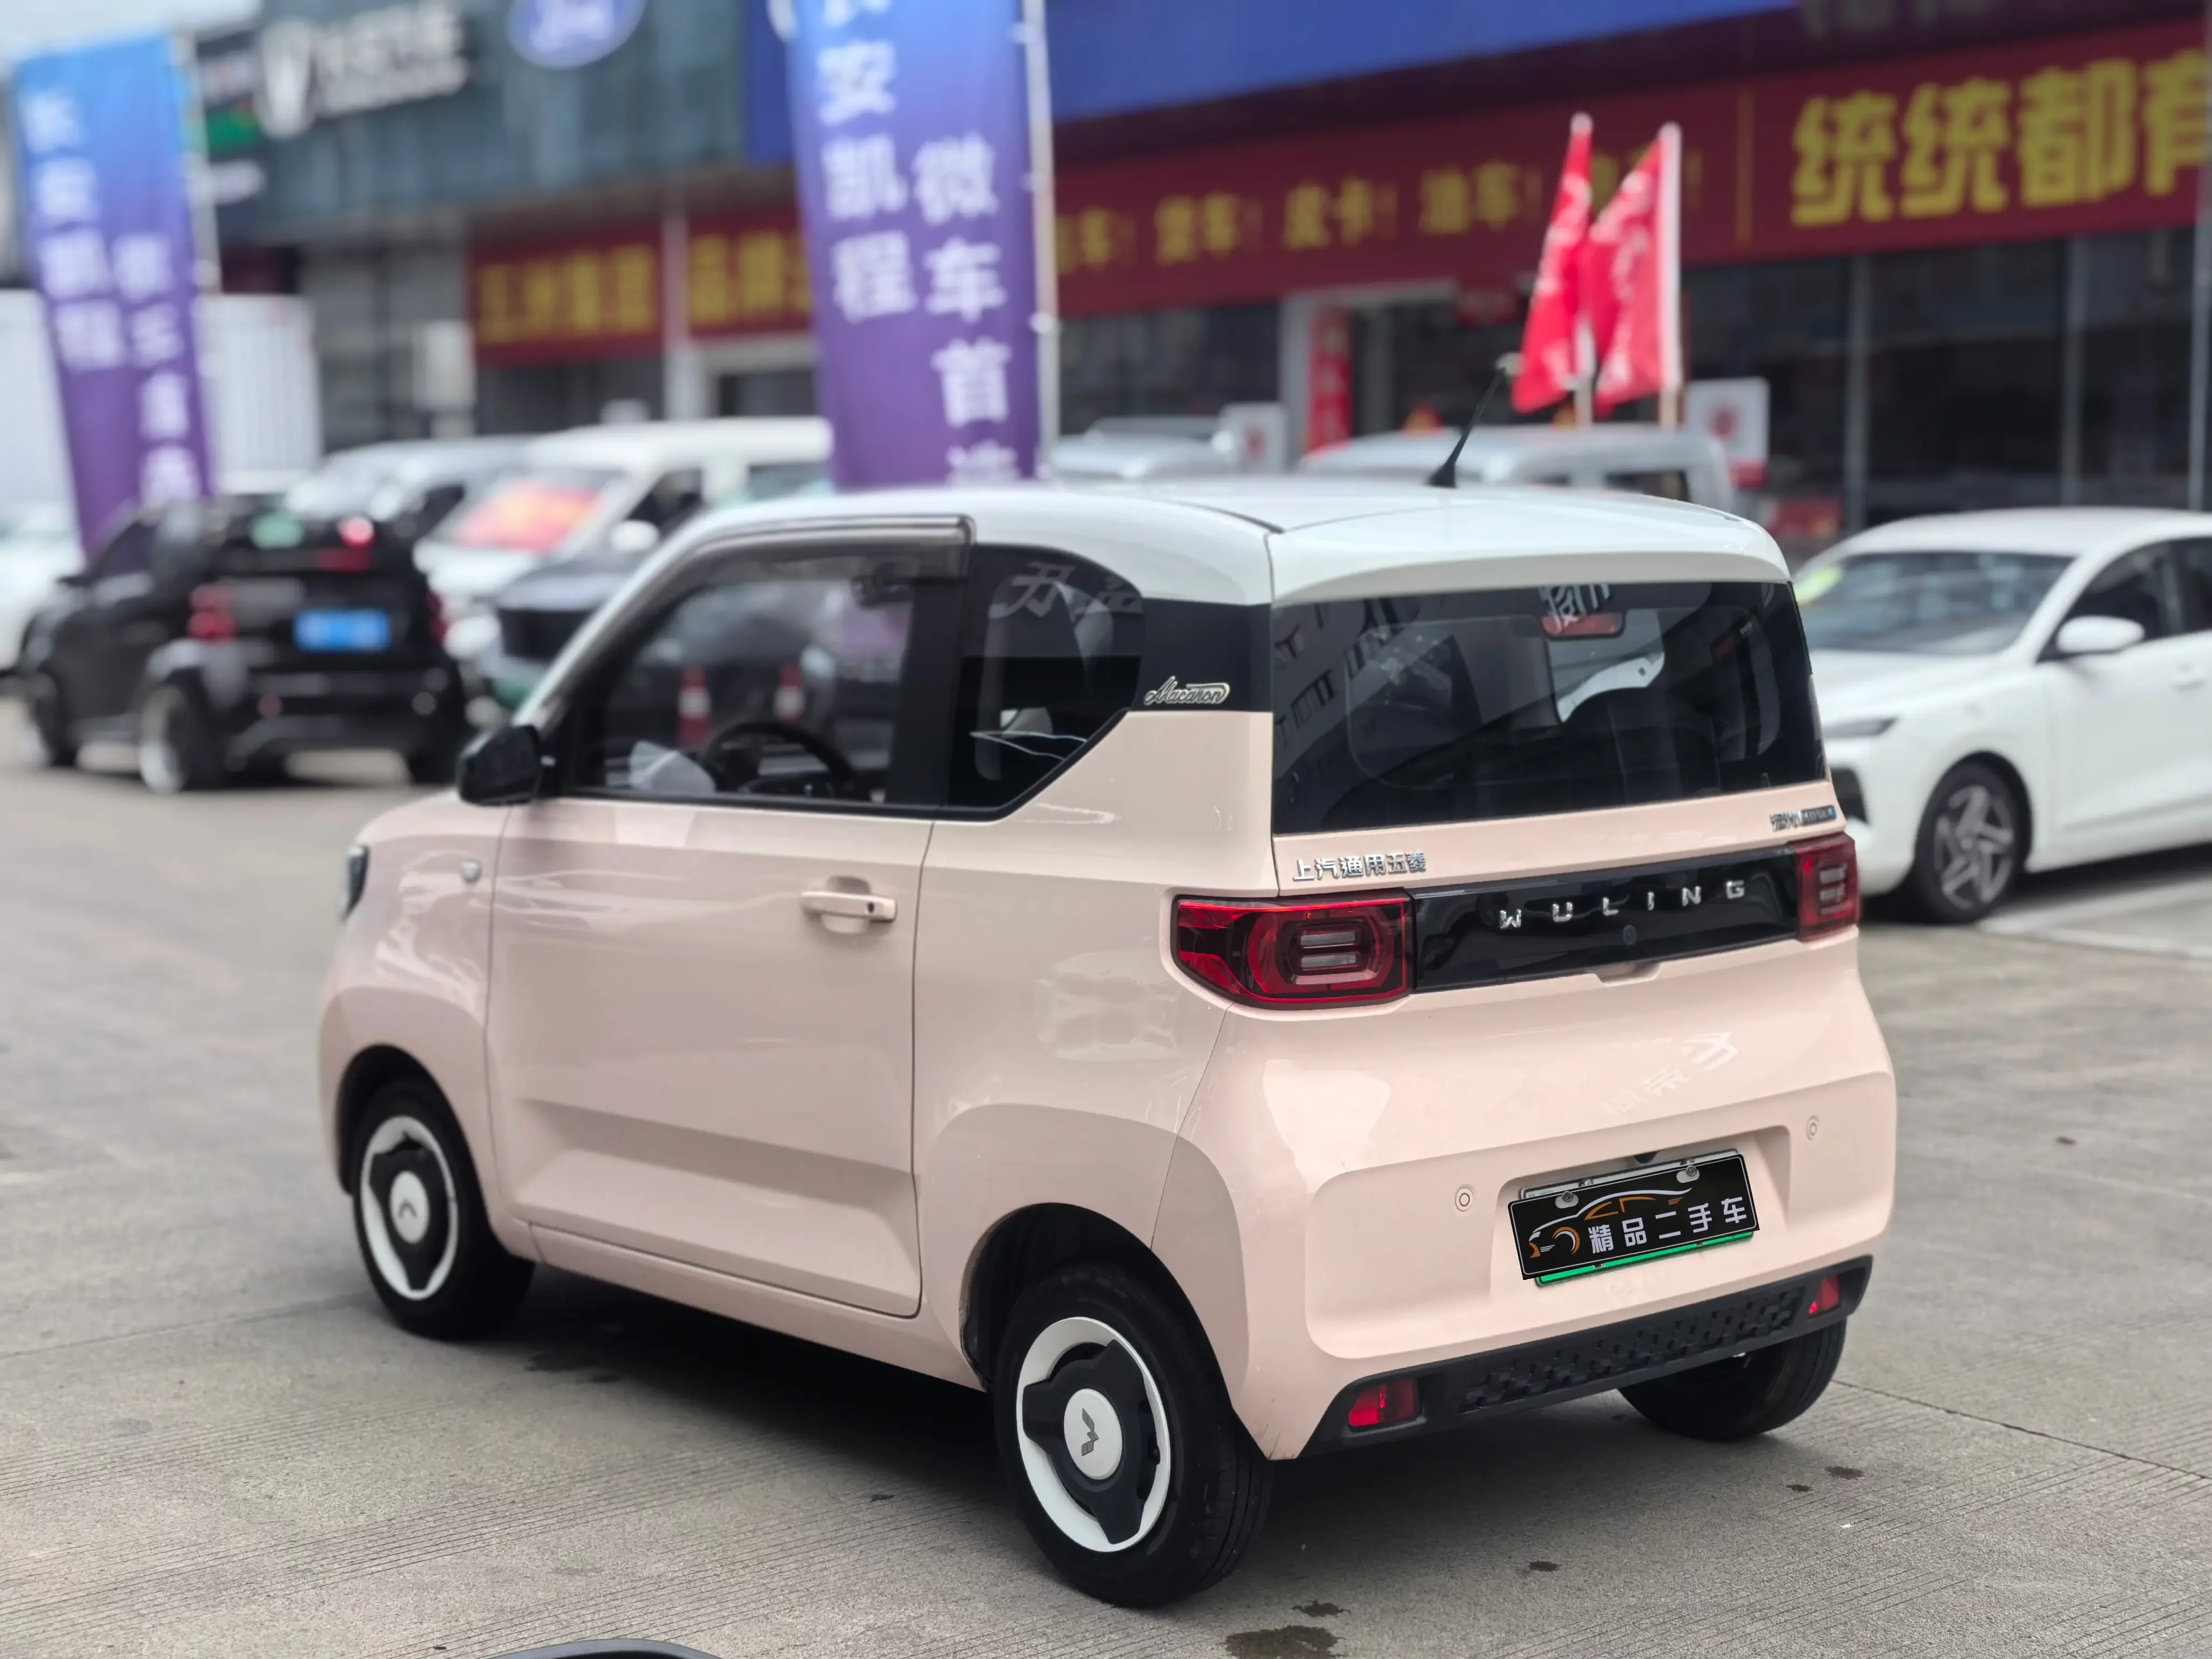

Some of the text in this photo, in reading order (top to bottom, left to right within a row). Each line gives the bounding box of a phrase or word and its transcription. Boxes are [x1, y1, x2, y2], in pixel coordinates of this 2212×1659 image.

[1791, 48, 2210, 227] 统统都有
[1143, 676, 1230, 706] Macaron
[1293, 852, 1427, 881] 上汽通用五菱
[1500, 880, 1745, 930] WULING
[1588, 1196, 1747, 1254] 精品二手车
